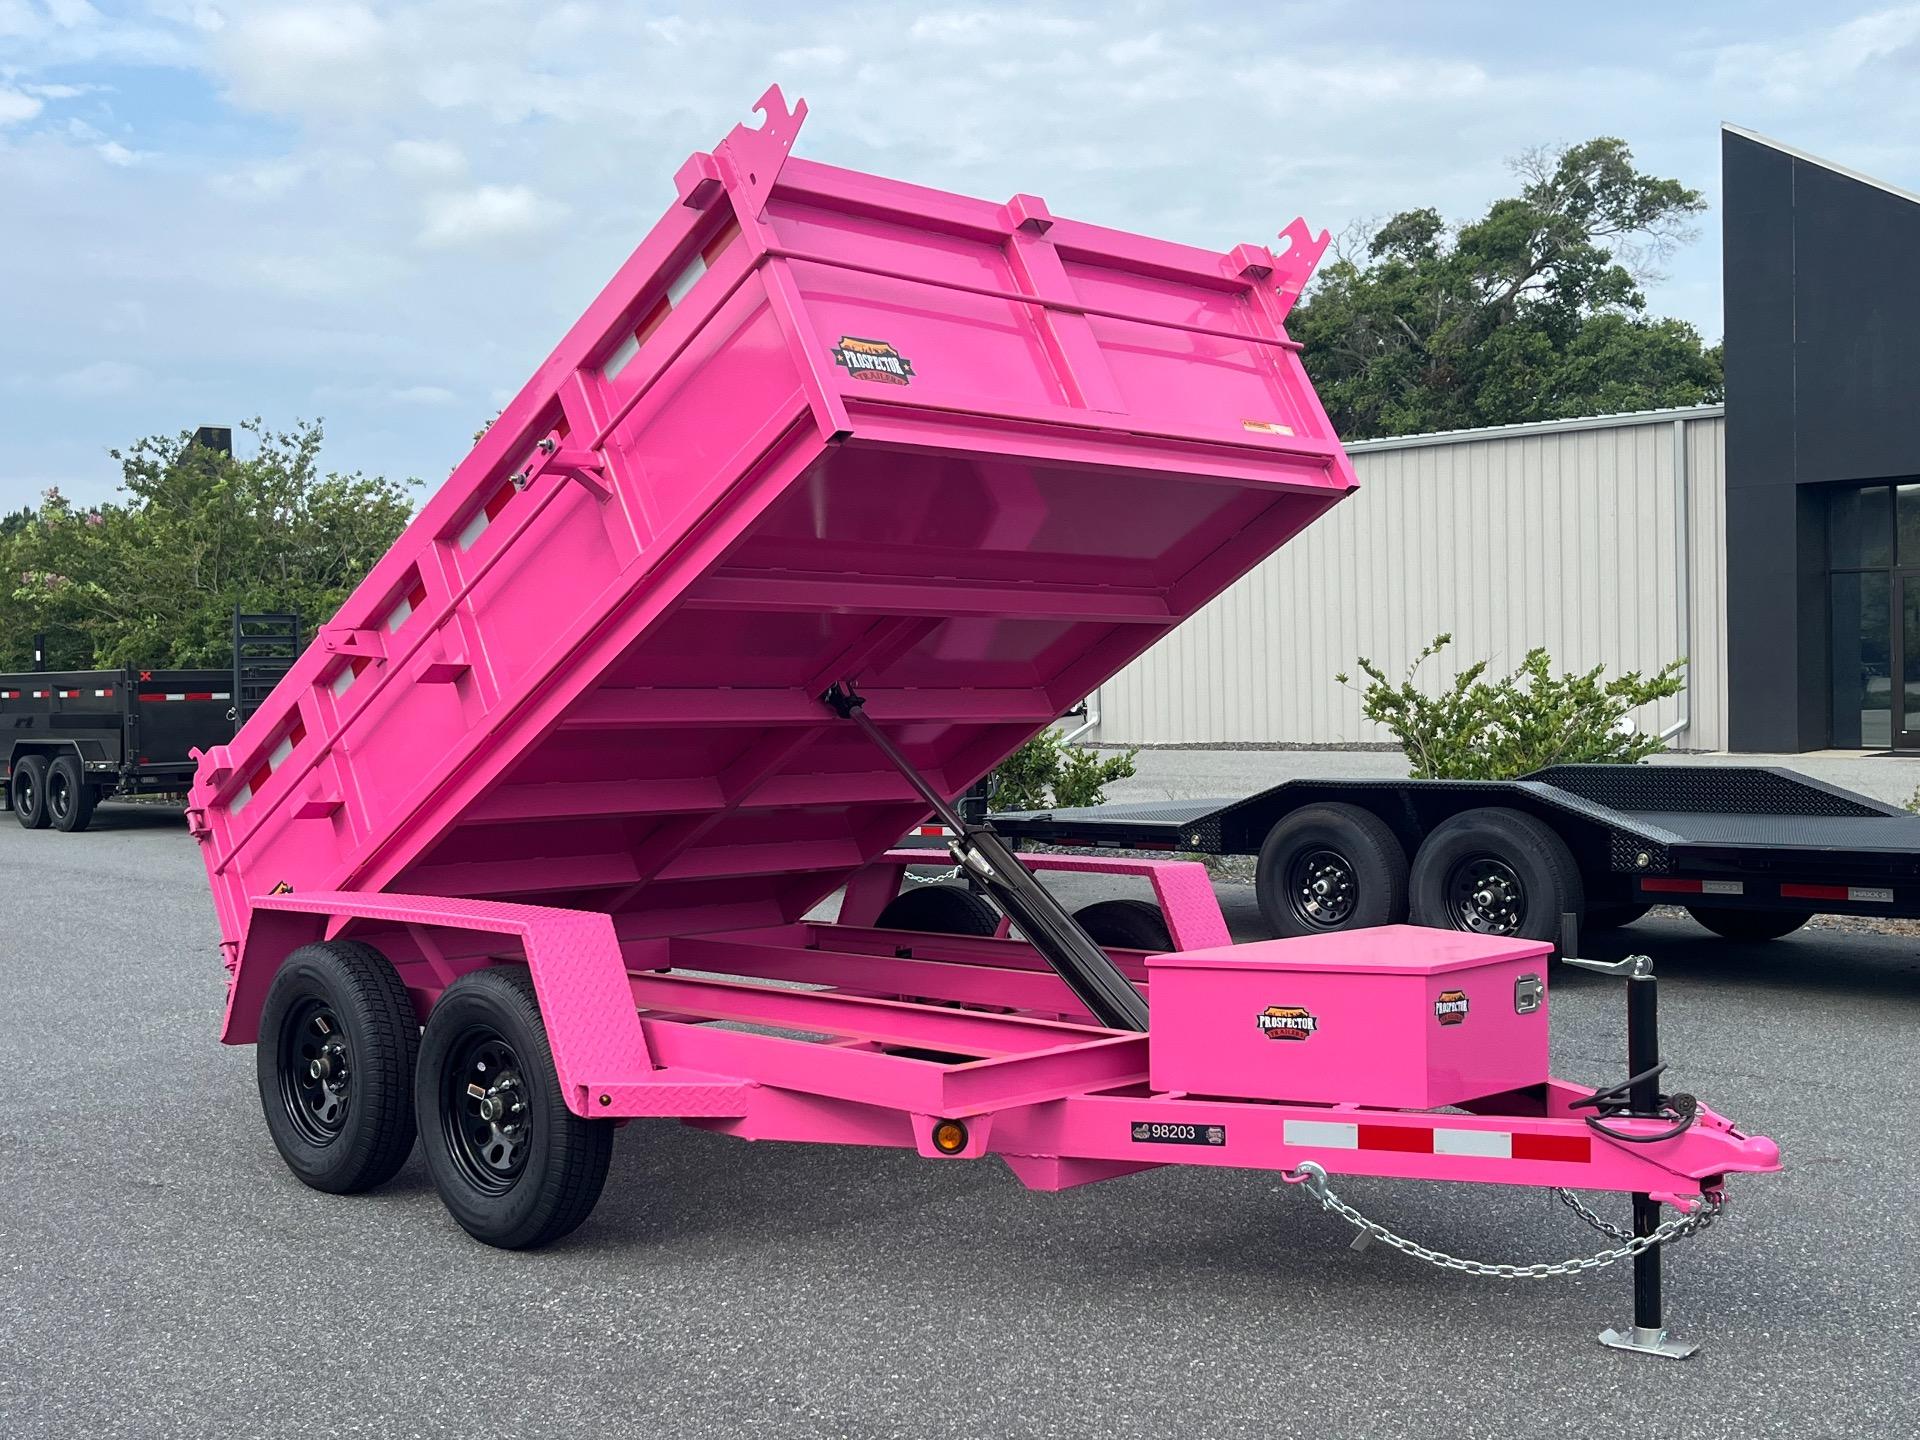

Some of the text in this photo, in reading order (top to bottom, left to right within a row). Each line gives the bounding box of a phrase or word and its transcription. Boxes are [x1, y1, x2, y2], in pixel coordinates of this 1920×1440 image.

[843, 350, 905, 375] PROSPECTOR
[1259, 1015, 1314, 1030] PROSPECTOR
[1152, 1125, 1196, 1139] 98203
